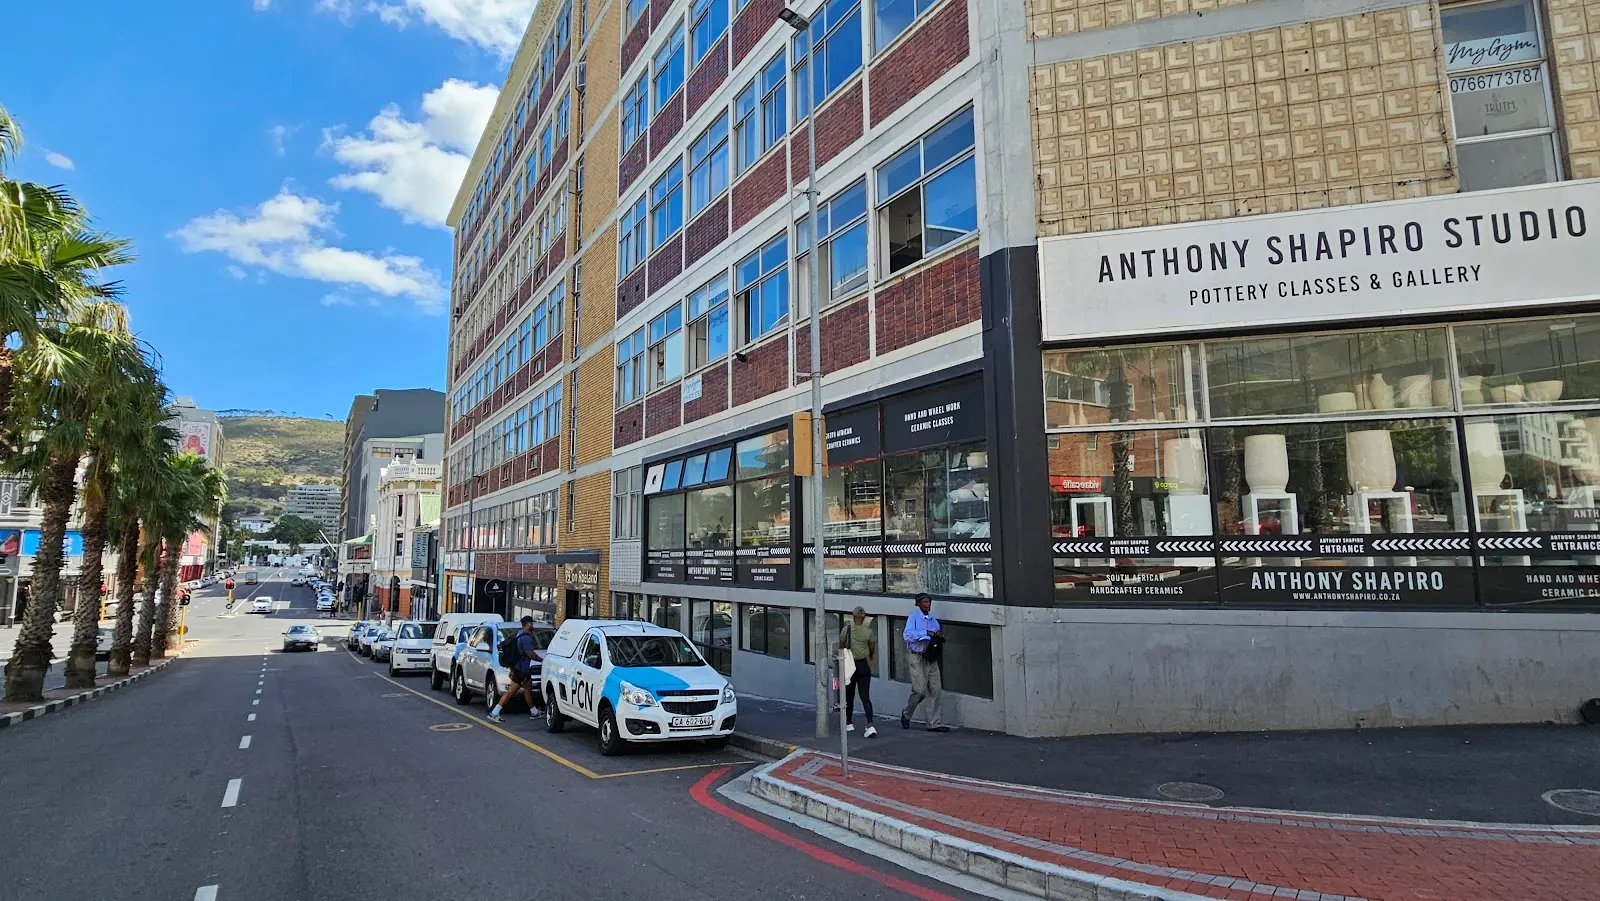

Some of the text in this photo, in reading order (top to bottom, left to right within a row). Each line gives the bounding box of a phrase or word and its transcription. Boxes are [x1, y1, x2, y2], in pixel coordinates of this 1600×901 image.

[1450, 67, 1540, 93] 0766773787
[1098, 205, 1587, 283] ANTHONY SHAPIRO STUDIO
[1189, 264, 1482, 306] POTTERY CLASSES & GALLERY
[932, 416, 954, 429] CLASSES
[925, 547, 947, 555] ENTRANCE
[1110, 546, 1150, 555] ENTRANCE
[1319, 544, 1365, 554] ENTRANCE
[1550, 541, 1600, 551] ENTRANCE
[1106, 573, 1165, 582] SOUTH AFRICAN
[1251, 571, 1444, 591] ANTHONY SHAPIRO
[1526, 574, 1552, 583] HAND
[1555, 574, 1575, 583] AND
[1090, 586, 1184, 595] HANDCRAFTED CERAMICS
[1541, 588, 1585, 597] CERAMIC
[1292, 592, 1401, 601] WWW.ANTHONYSHAPIRO.CO.ZA
[571, 676, 594, 712] PCN
